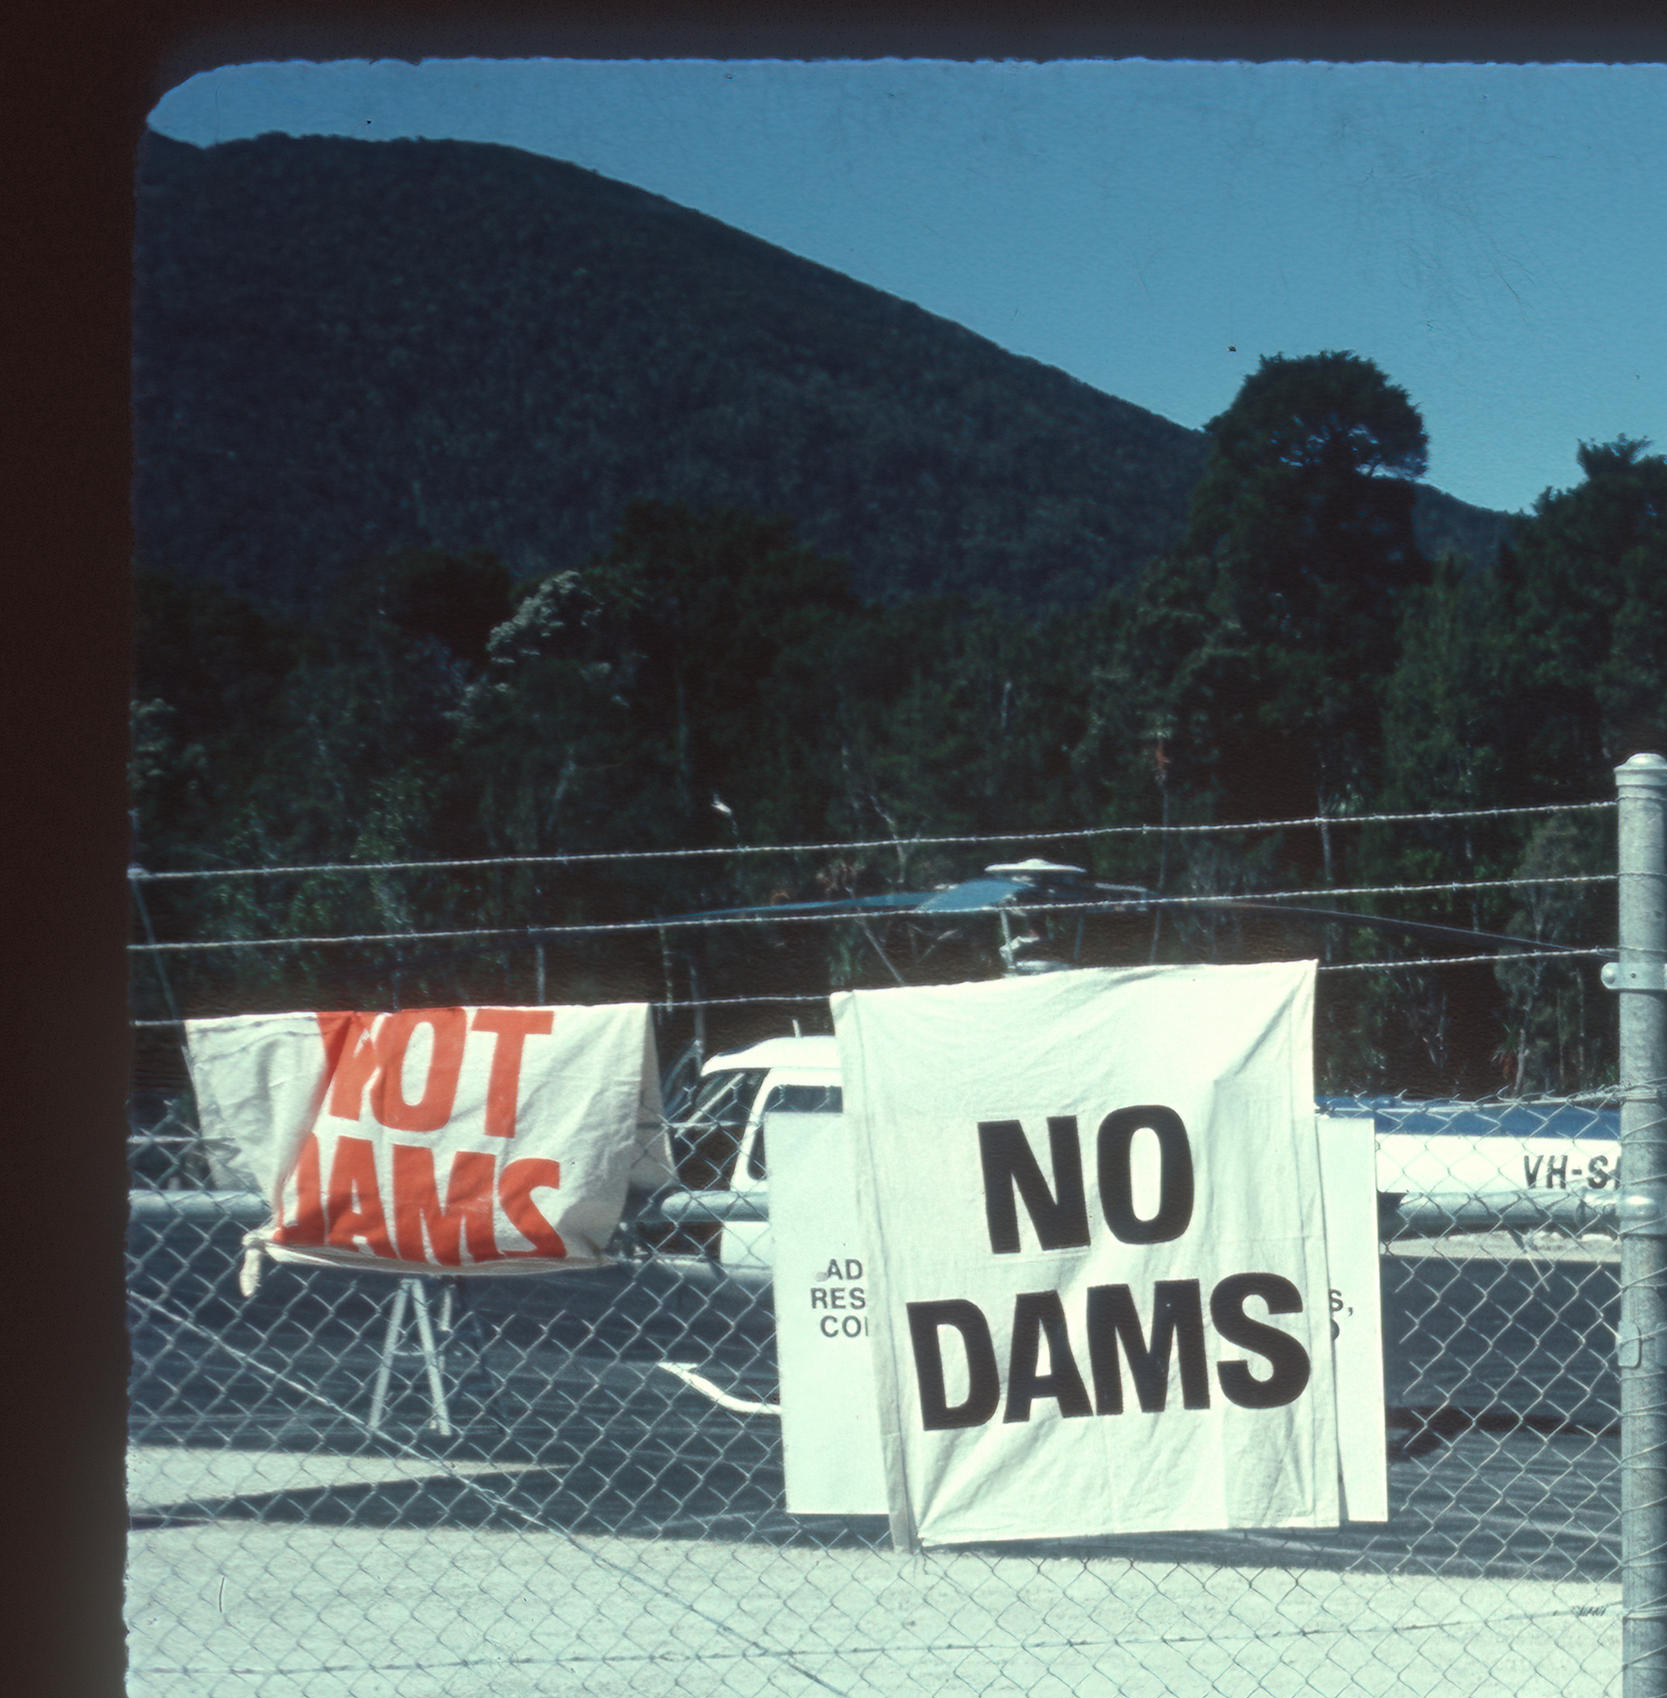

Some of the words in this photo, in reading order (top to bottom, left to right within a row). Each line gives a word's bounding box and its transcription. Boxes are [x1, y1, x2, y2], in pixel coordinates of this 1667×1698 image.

[977, 1104, 1195, 1254] NO
[1523, 1154, 1622, 1191] VH-S
[827, 1259, 864, 1280] AD
[810, 1287, 867, 1310] RES
[820, 1315, 869, 1338] CO
[906, 1271, 1312, 1432] DAMS
